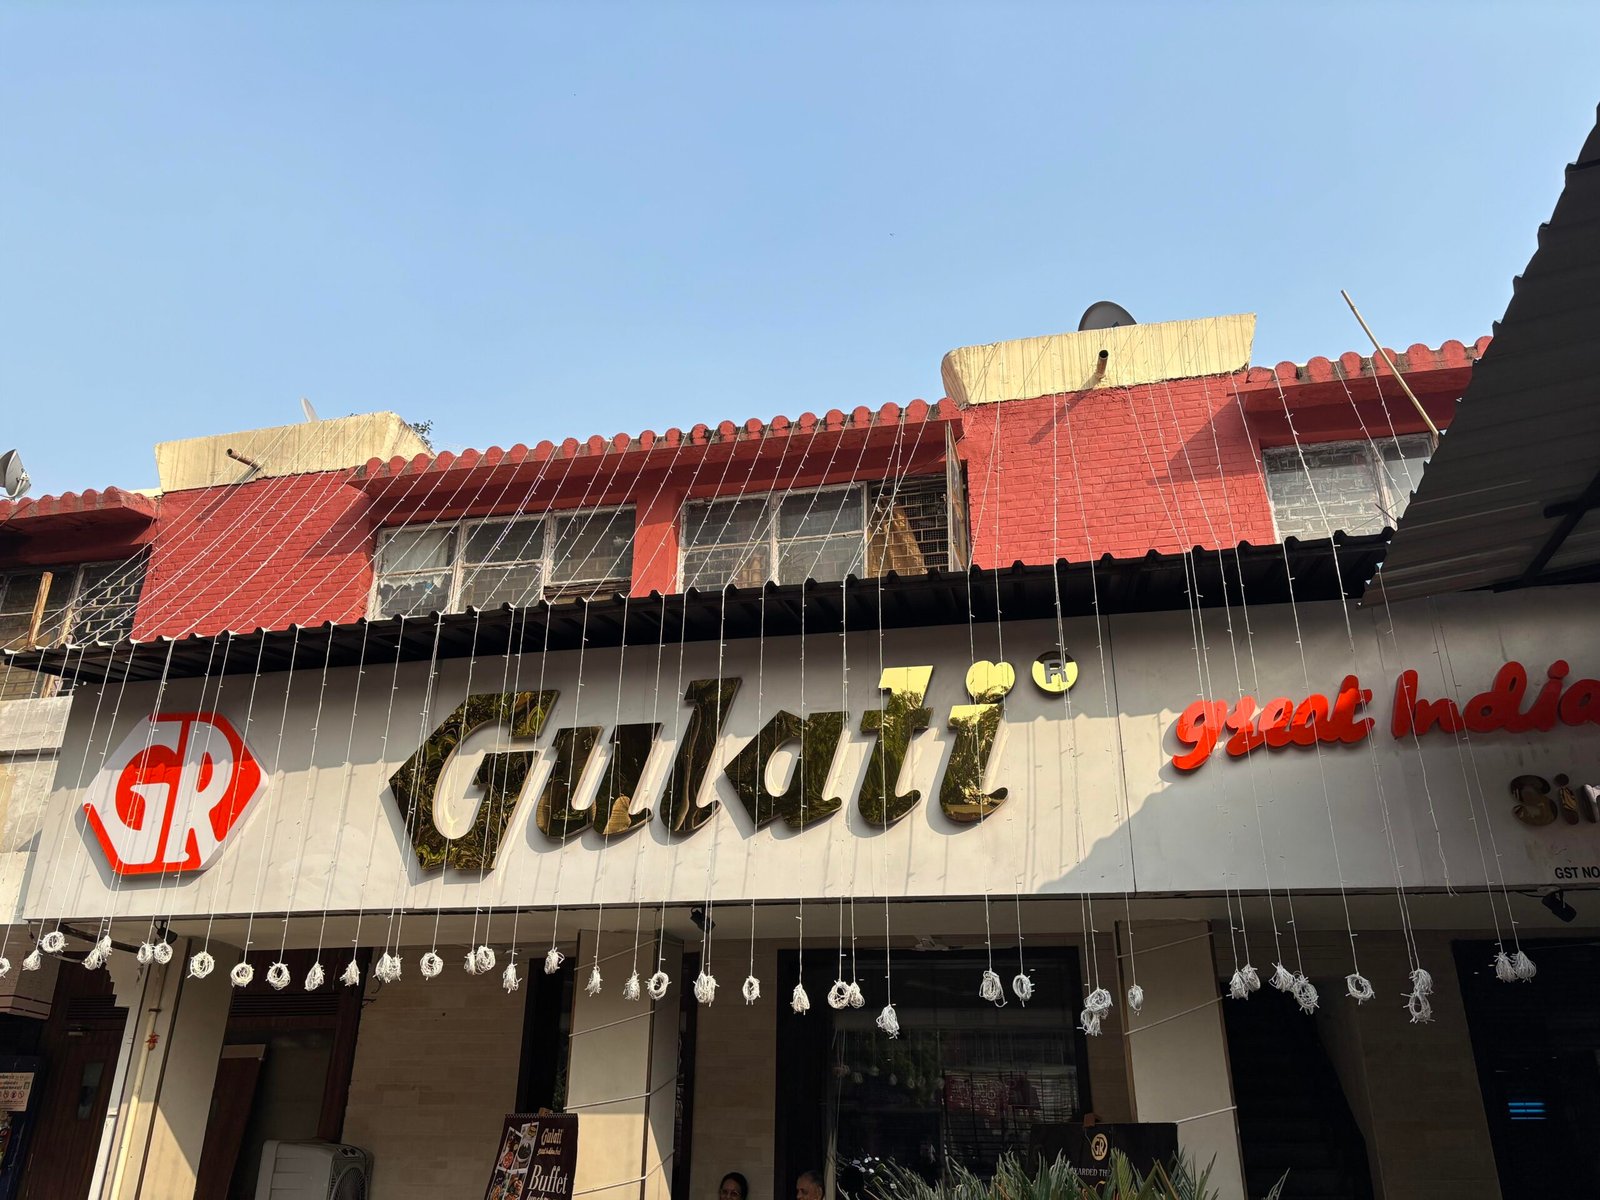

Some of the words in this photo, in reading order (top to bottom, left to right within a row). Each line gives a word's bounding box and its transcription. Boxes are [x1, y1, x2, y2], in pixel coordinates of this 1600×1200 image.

[1172, 674, 1375, 770] great
[388, 660, 1015, 871] Gulati
[1554, 866, 1578, 879] GST
[528, 1164, 568, 1195] Buffet
[1071, 1166, 1098, 1177] ARDED
